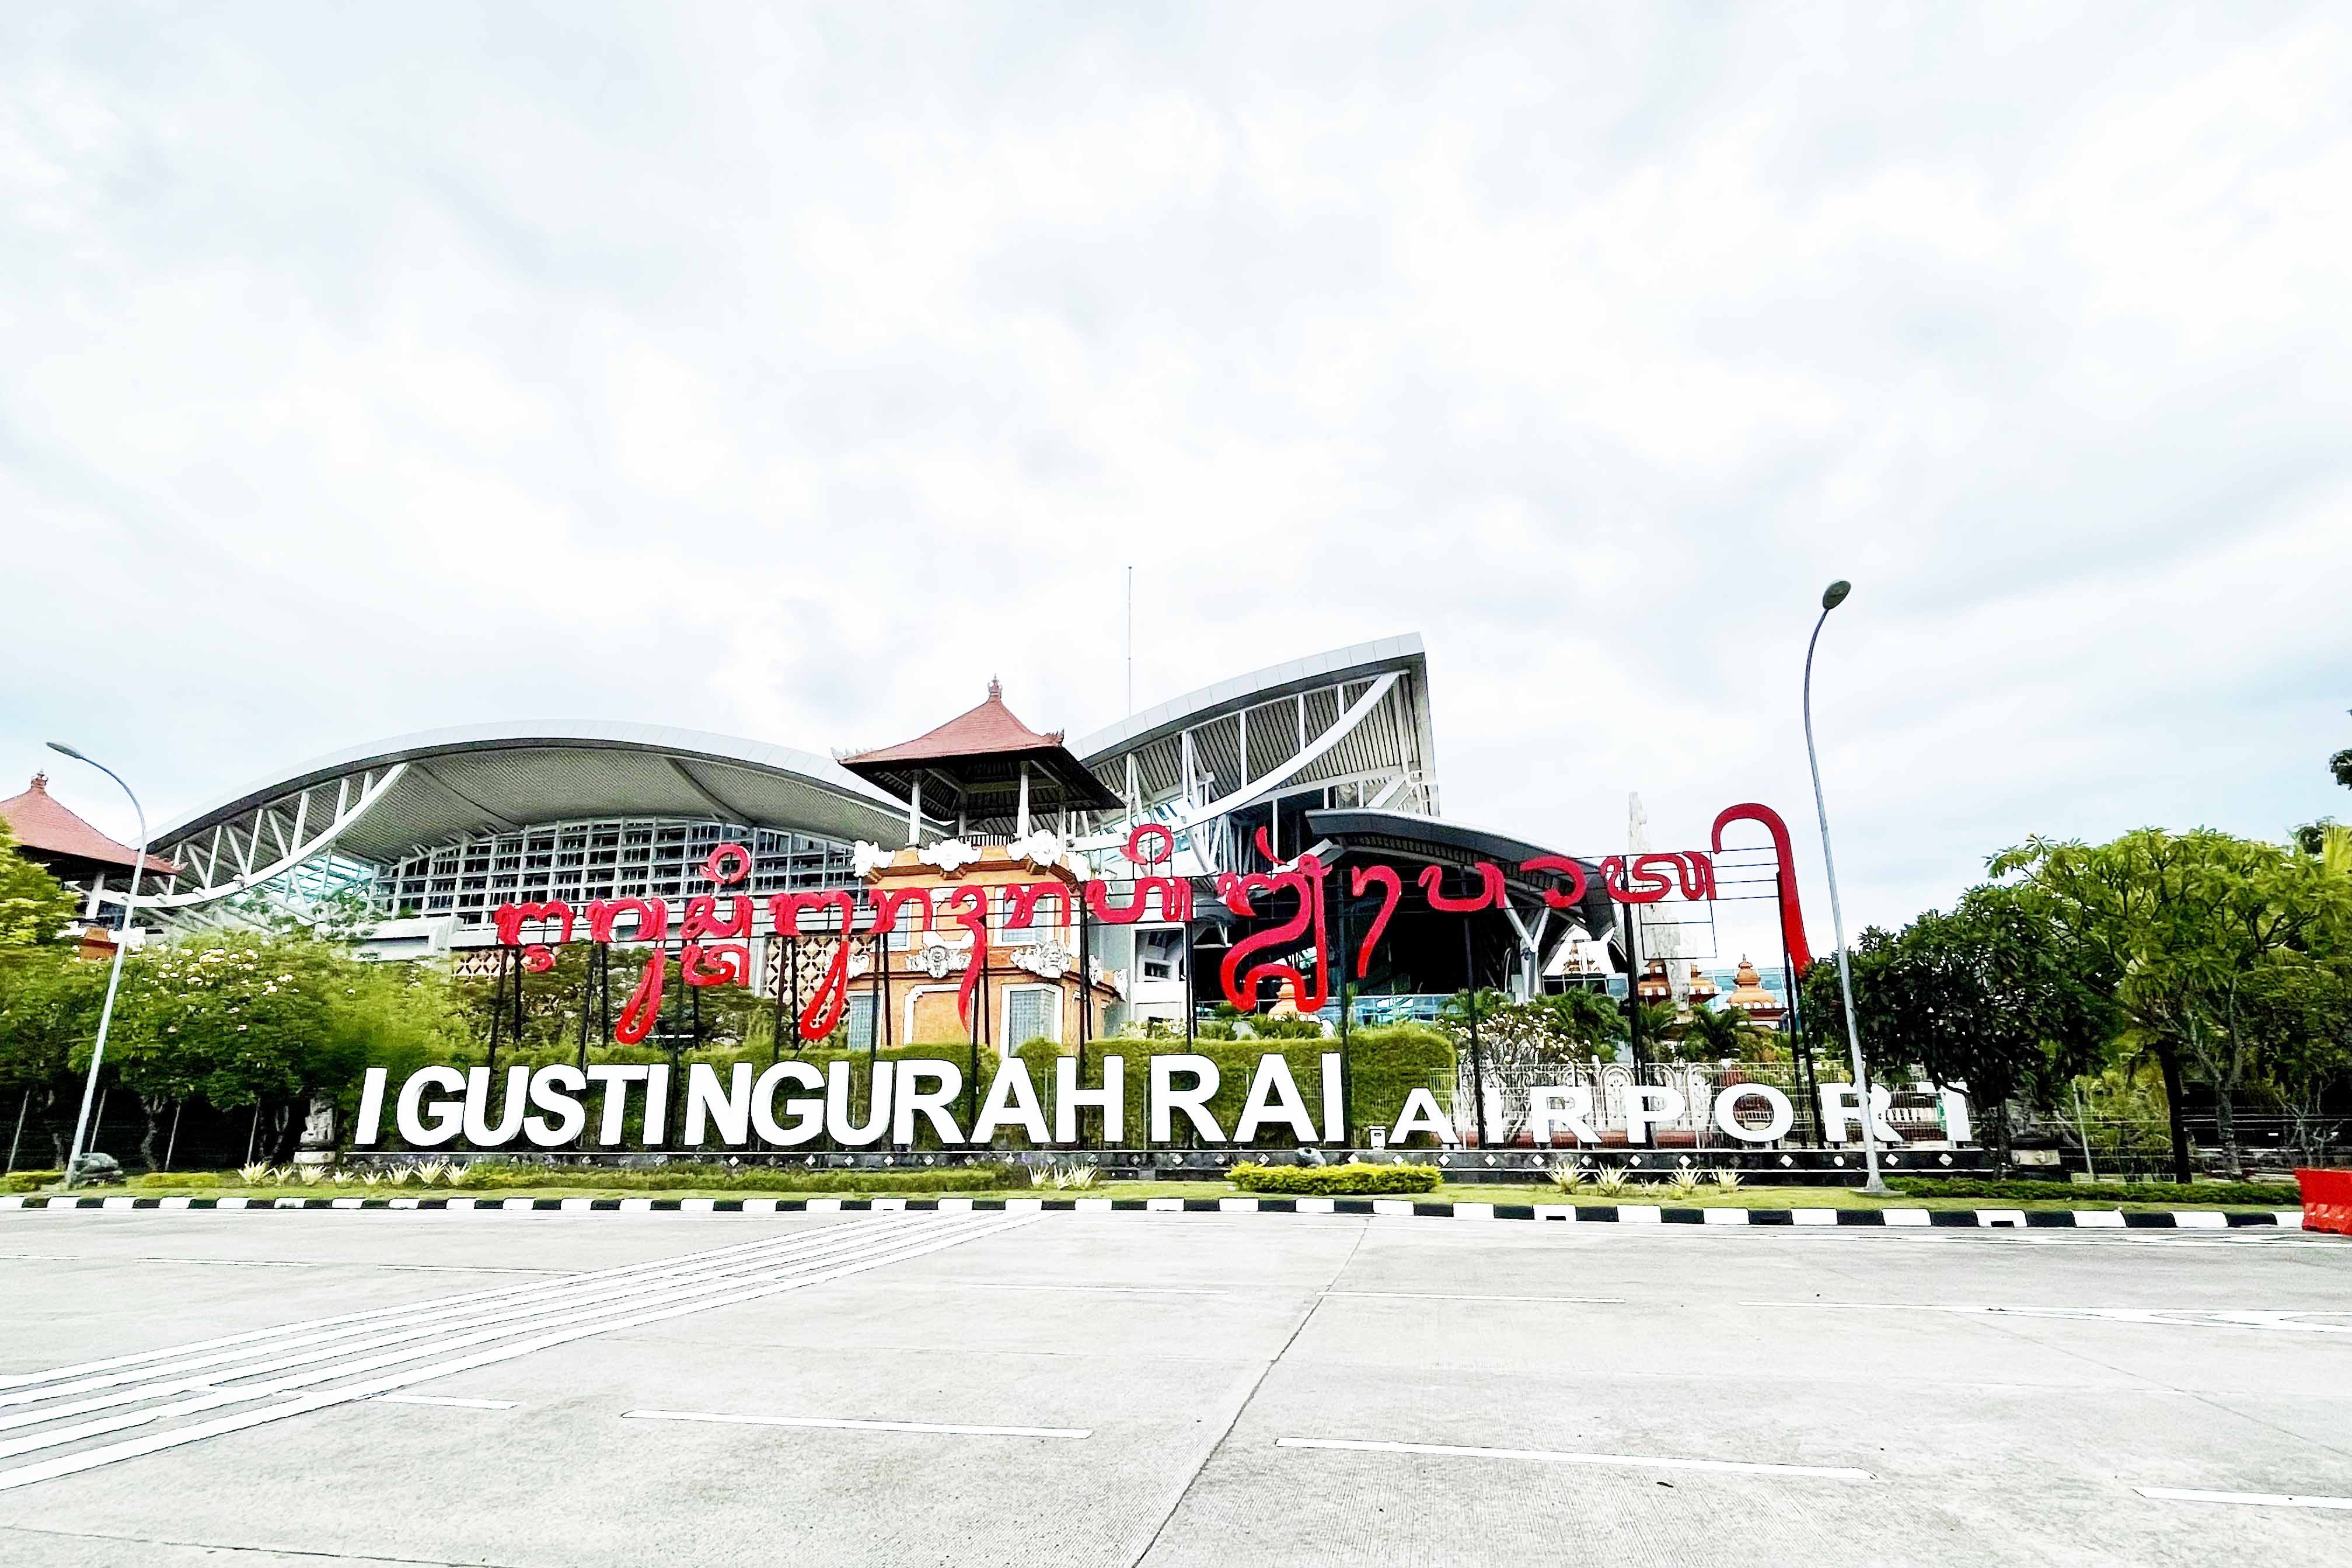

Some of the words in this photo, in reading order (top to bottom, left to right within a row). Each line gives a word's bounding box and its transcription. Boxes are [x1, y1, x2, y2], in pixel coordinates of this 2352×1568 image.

[354, 1067, 389, 1145] I
[396, 1063, 670, 1147] GUSTI
[683, 1055, 1124, 1147] NGURAH
[1149, 1052, 1344, 1144] RAI
[1387, 1082, 1973, 1144] AIRPORT
